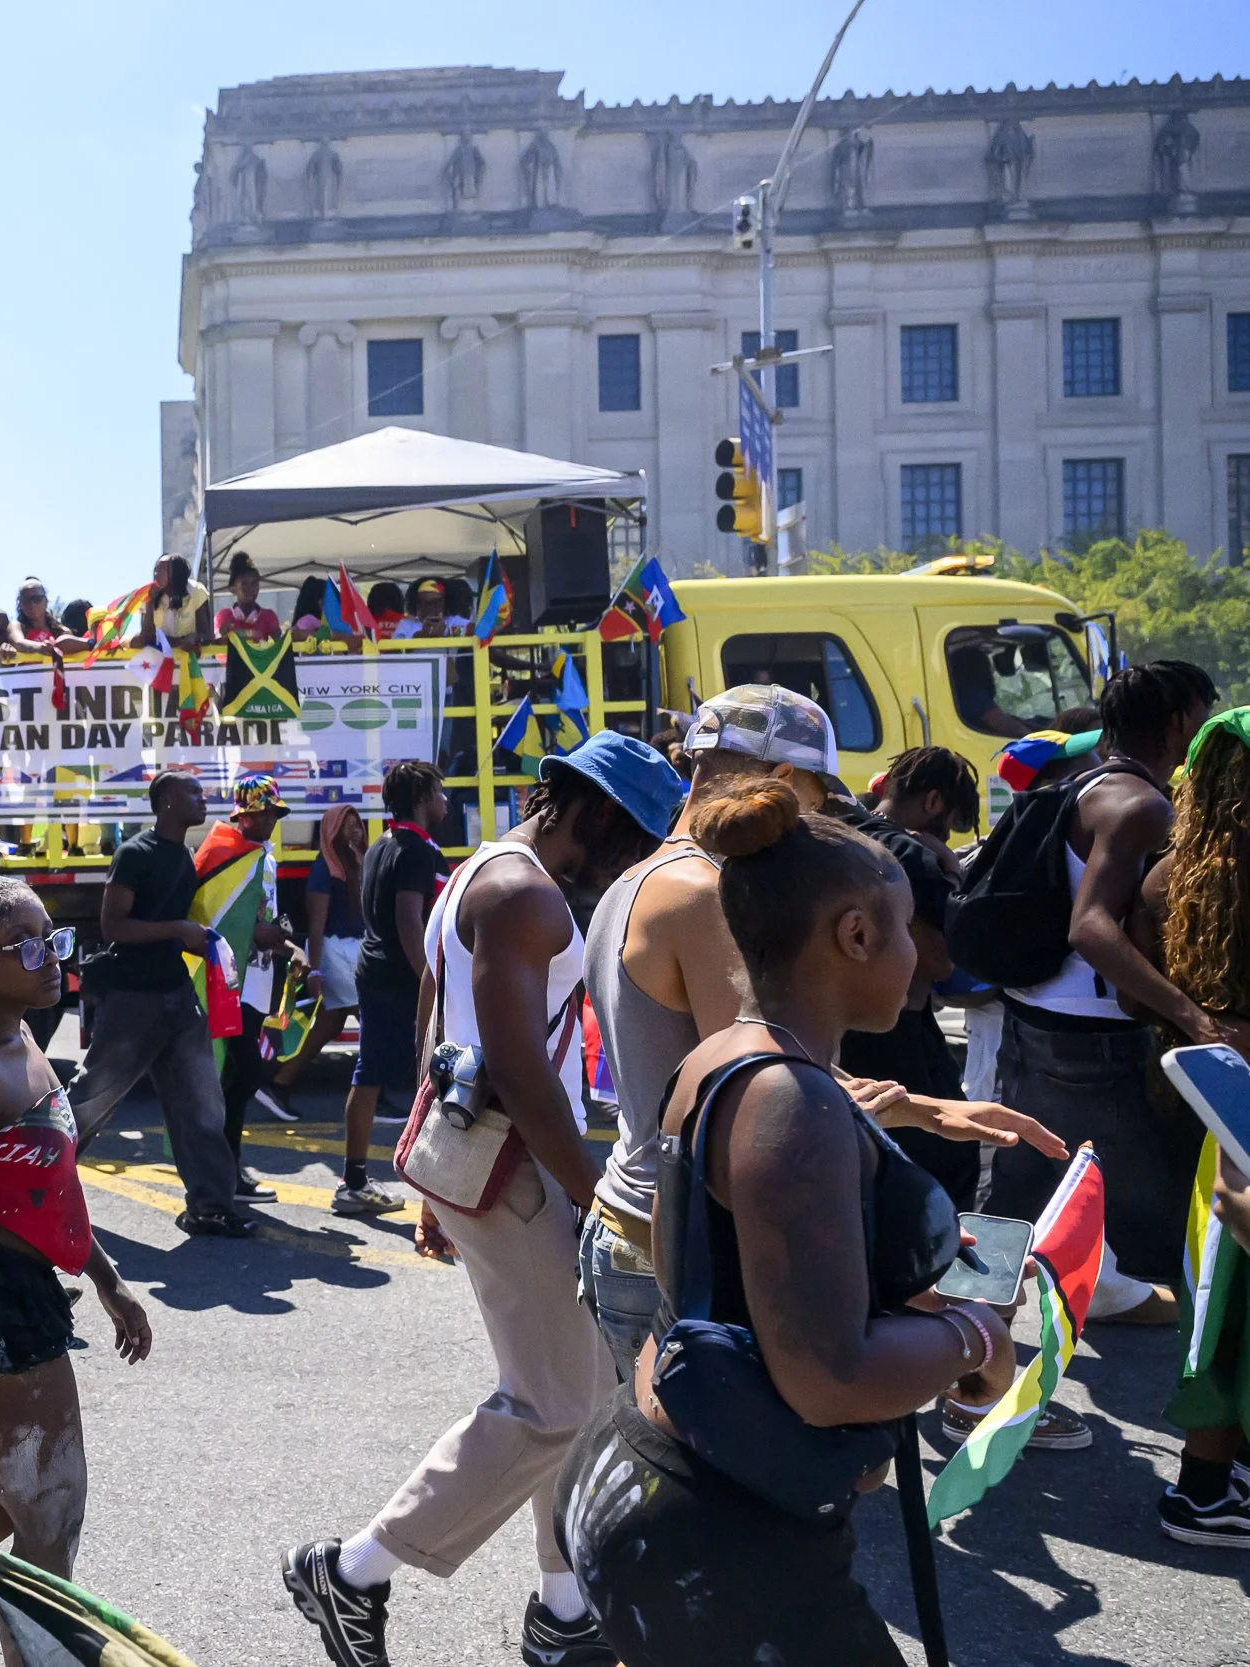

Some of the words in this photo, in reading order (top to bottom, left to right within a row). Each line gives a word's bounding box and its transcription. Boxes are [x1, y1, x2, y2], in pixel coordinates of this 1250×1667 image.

[298, 686, 330, 695] NEW
[341, 685, 381, 694] YORK
[388, 684, 421, 693] CITY
[245, 704, 283, 713] JAMAICA
[300, 698, 422, 731] DOT
[61, 722, 131, 749] DAY
[142, 718, 288, 748] PARADE
